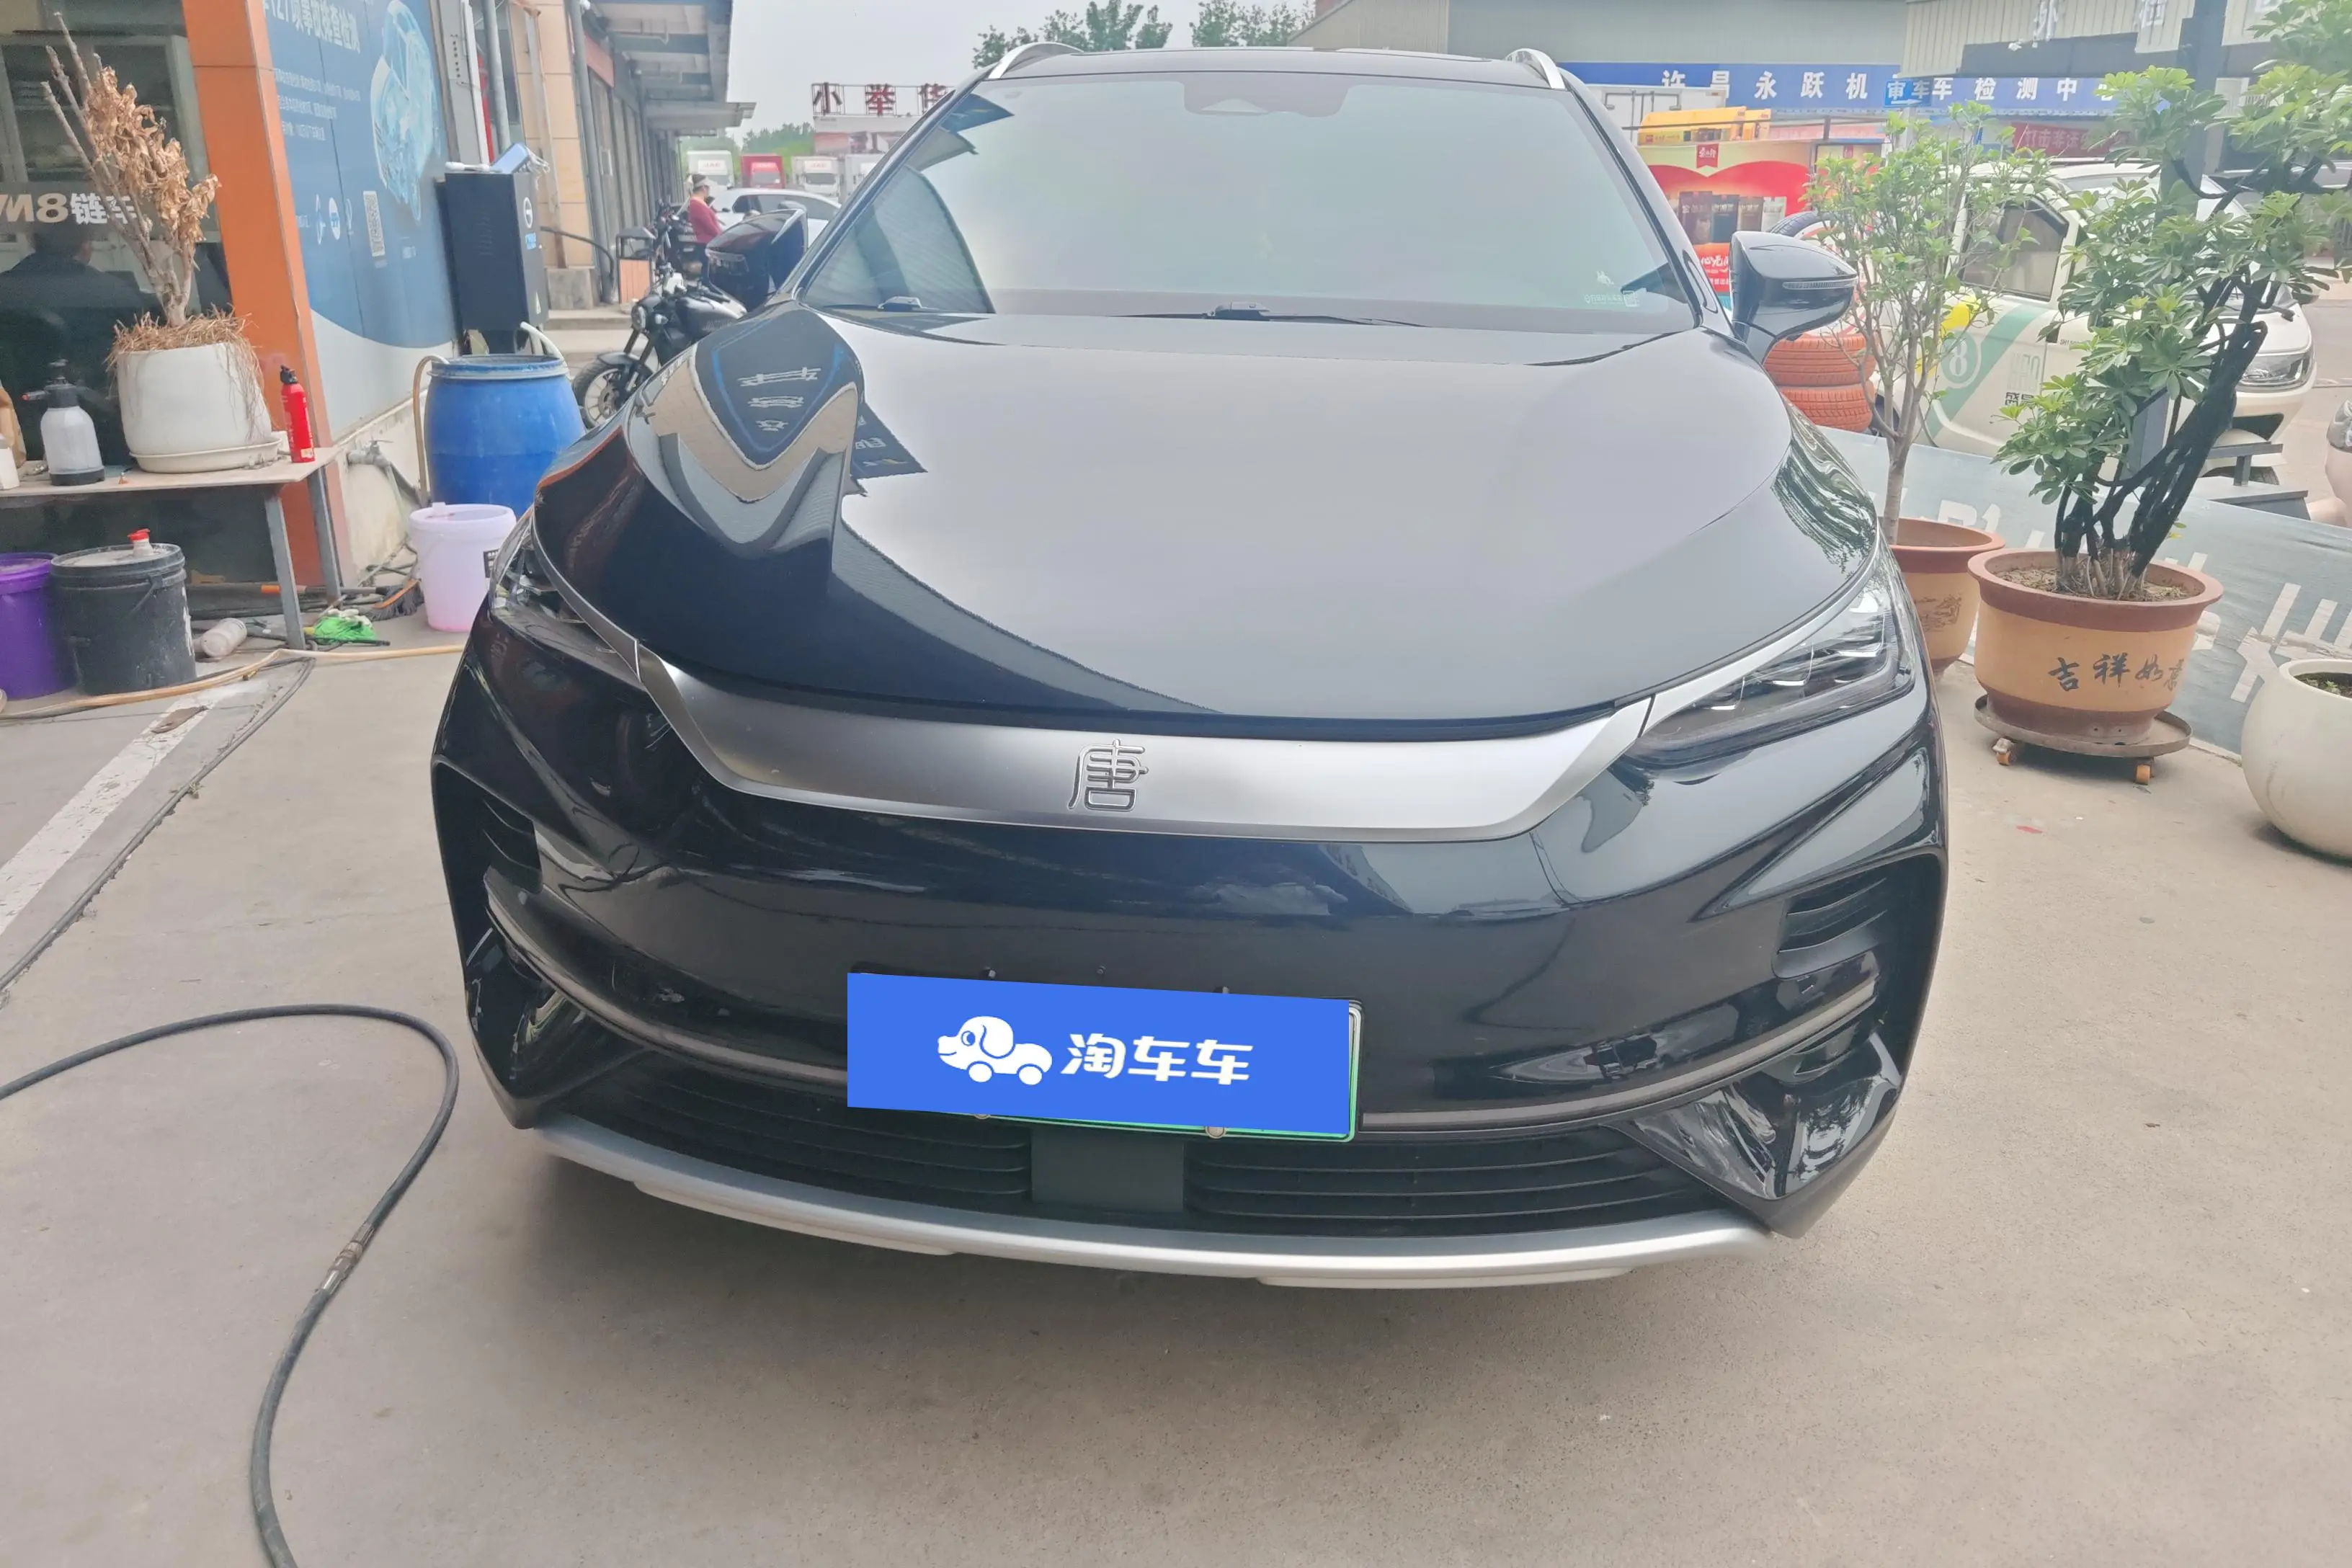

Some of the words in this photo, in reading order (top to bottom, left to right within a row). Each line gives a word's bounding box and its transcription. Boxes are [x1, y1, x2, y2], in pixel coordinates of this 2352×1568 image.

[1662, 70, 2113, 102] 许昌永跃机车检测中
[1886, 80, 1930, 100] 审车
[2048, 651, 2185, 692] 吉祥如意
[1066, 739, 1149, 811] 唐
